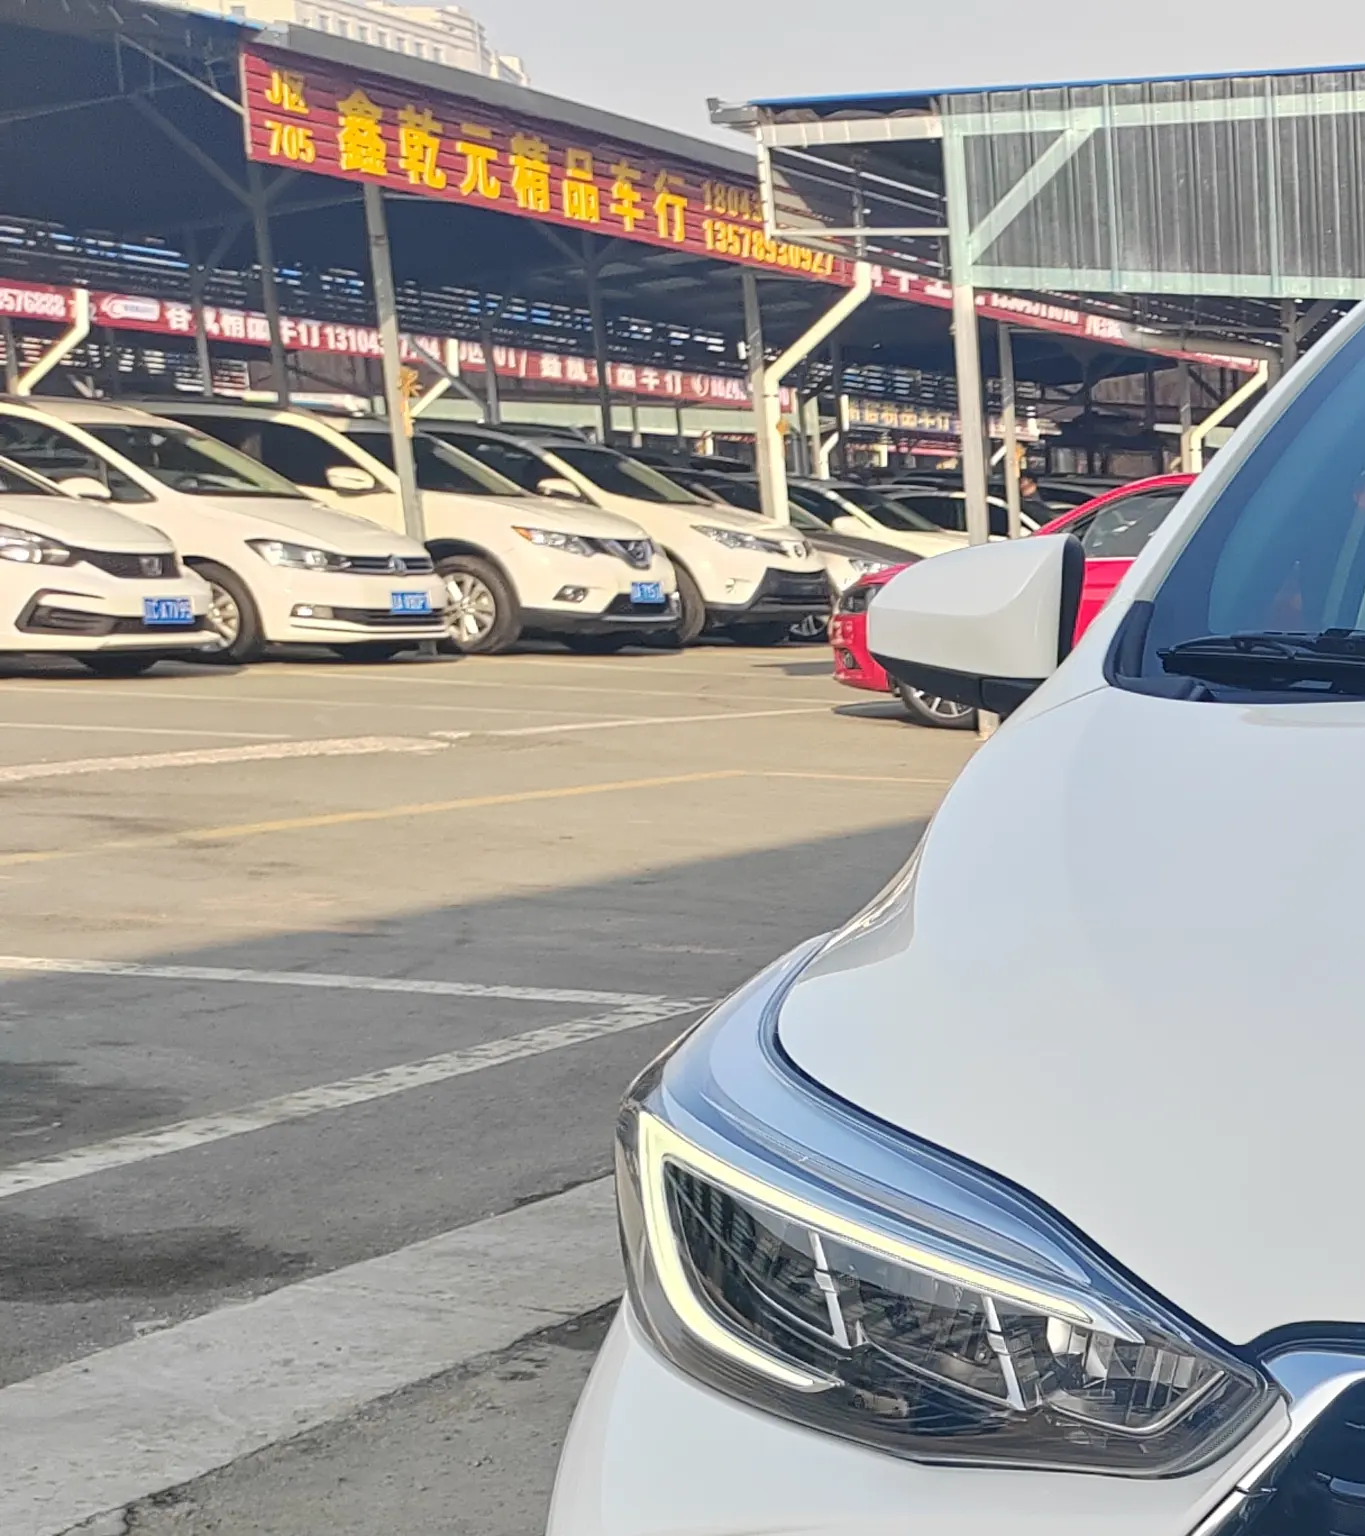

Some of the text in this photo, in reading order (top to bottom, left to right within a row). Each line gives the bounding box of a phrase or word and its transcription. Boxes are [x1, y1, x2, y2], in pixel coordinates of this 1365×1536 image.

[264, 120, 317, 164] 705
[336, 88, 688, 243] 鑫乾元精品车行
